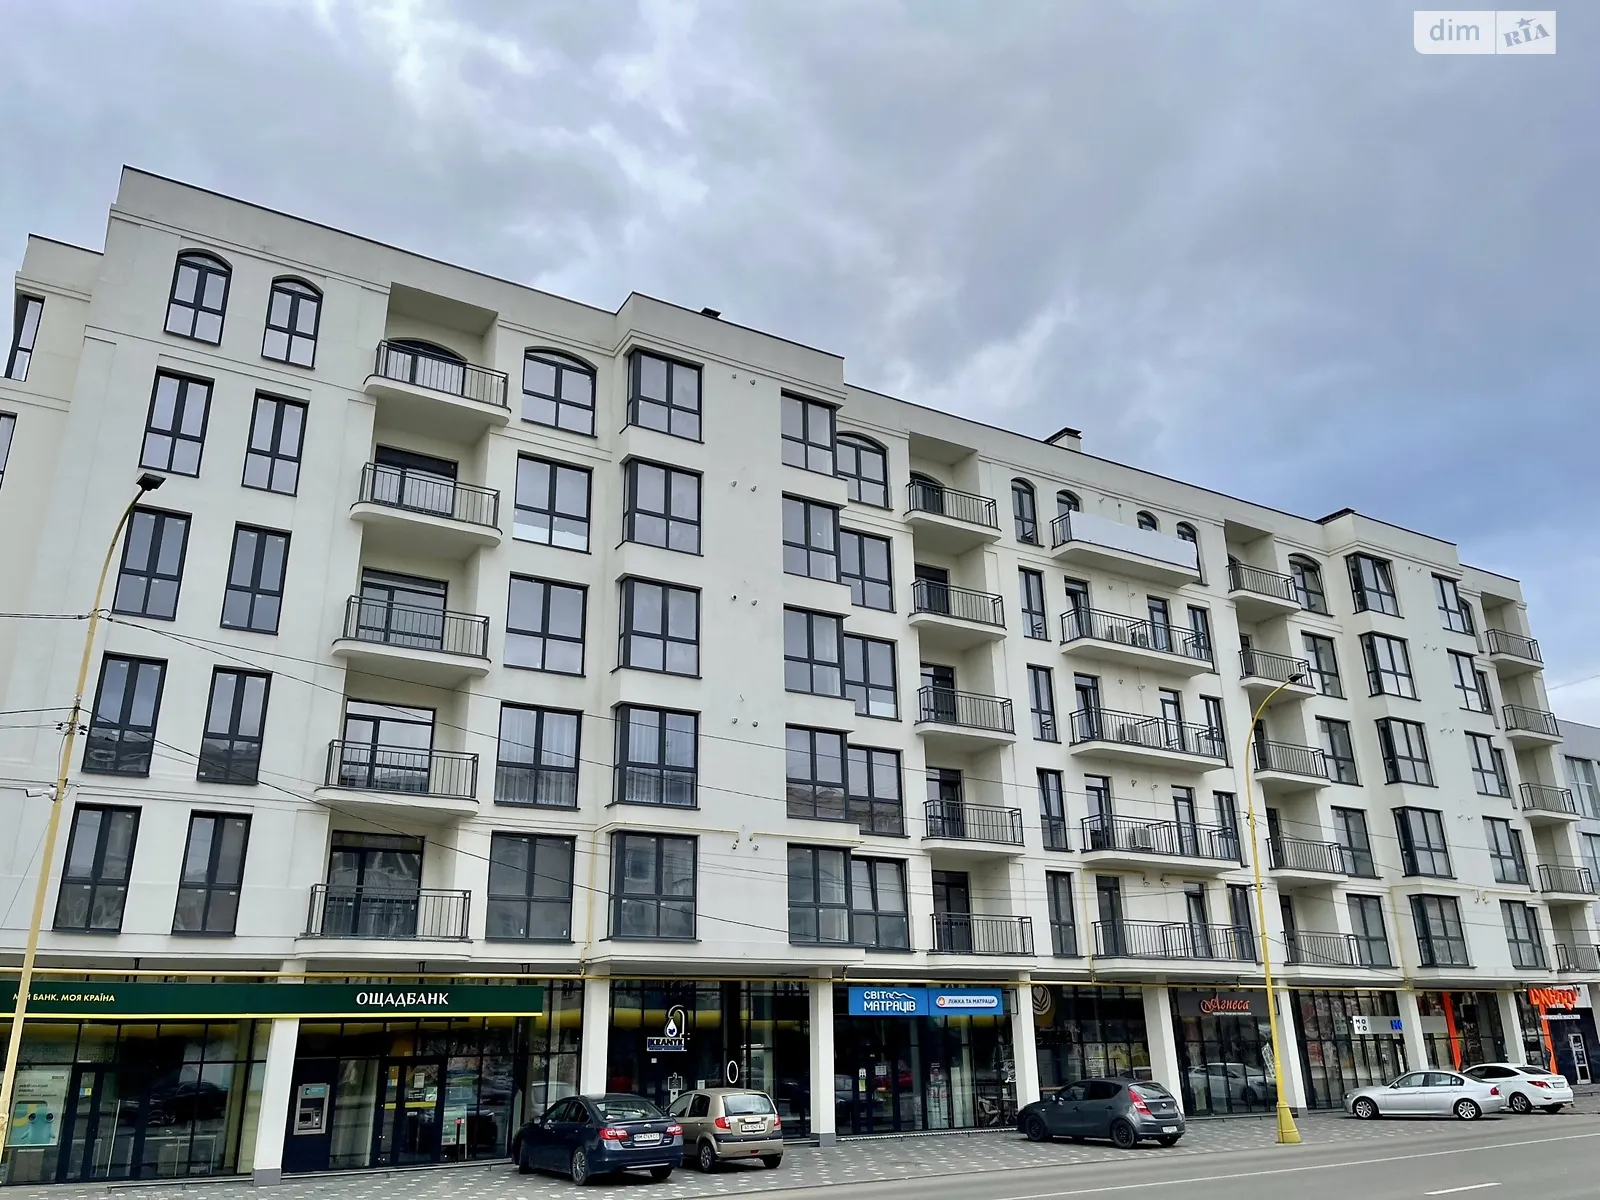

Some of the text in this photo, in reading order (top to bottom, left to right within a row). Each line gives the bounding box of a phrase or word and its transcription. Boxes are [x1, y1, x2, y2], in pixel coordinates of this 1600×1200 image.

[60, 994, 82, 1002] МОЯ
[83, 993, 115, 1002] КРАЇНА
[356, 992, 449, 1008] ОЩАДБАНК
[863, 990, 887, 1000] СВІТ
[863, 1000, 916, 1013] МАТРАЦІВ
